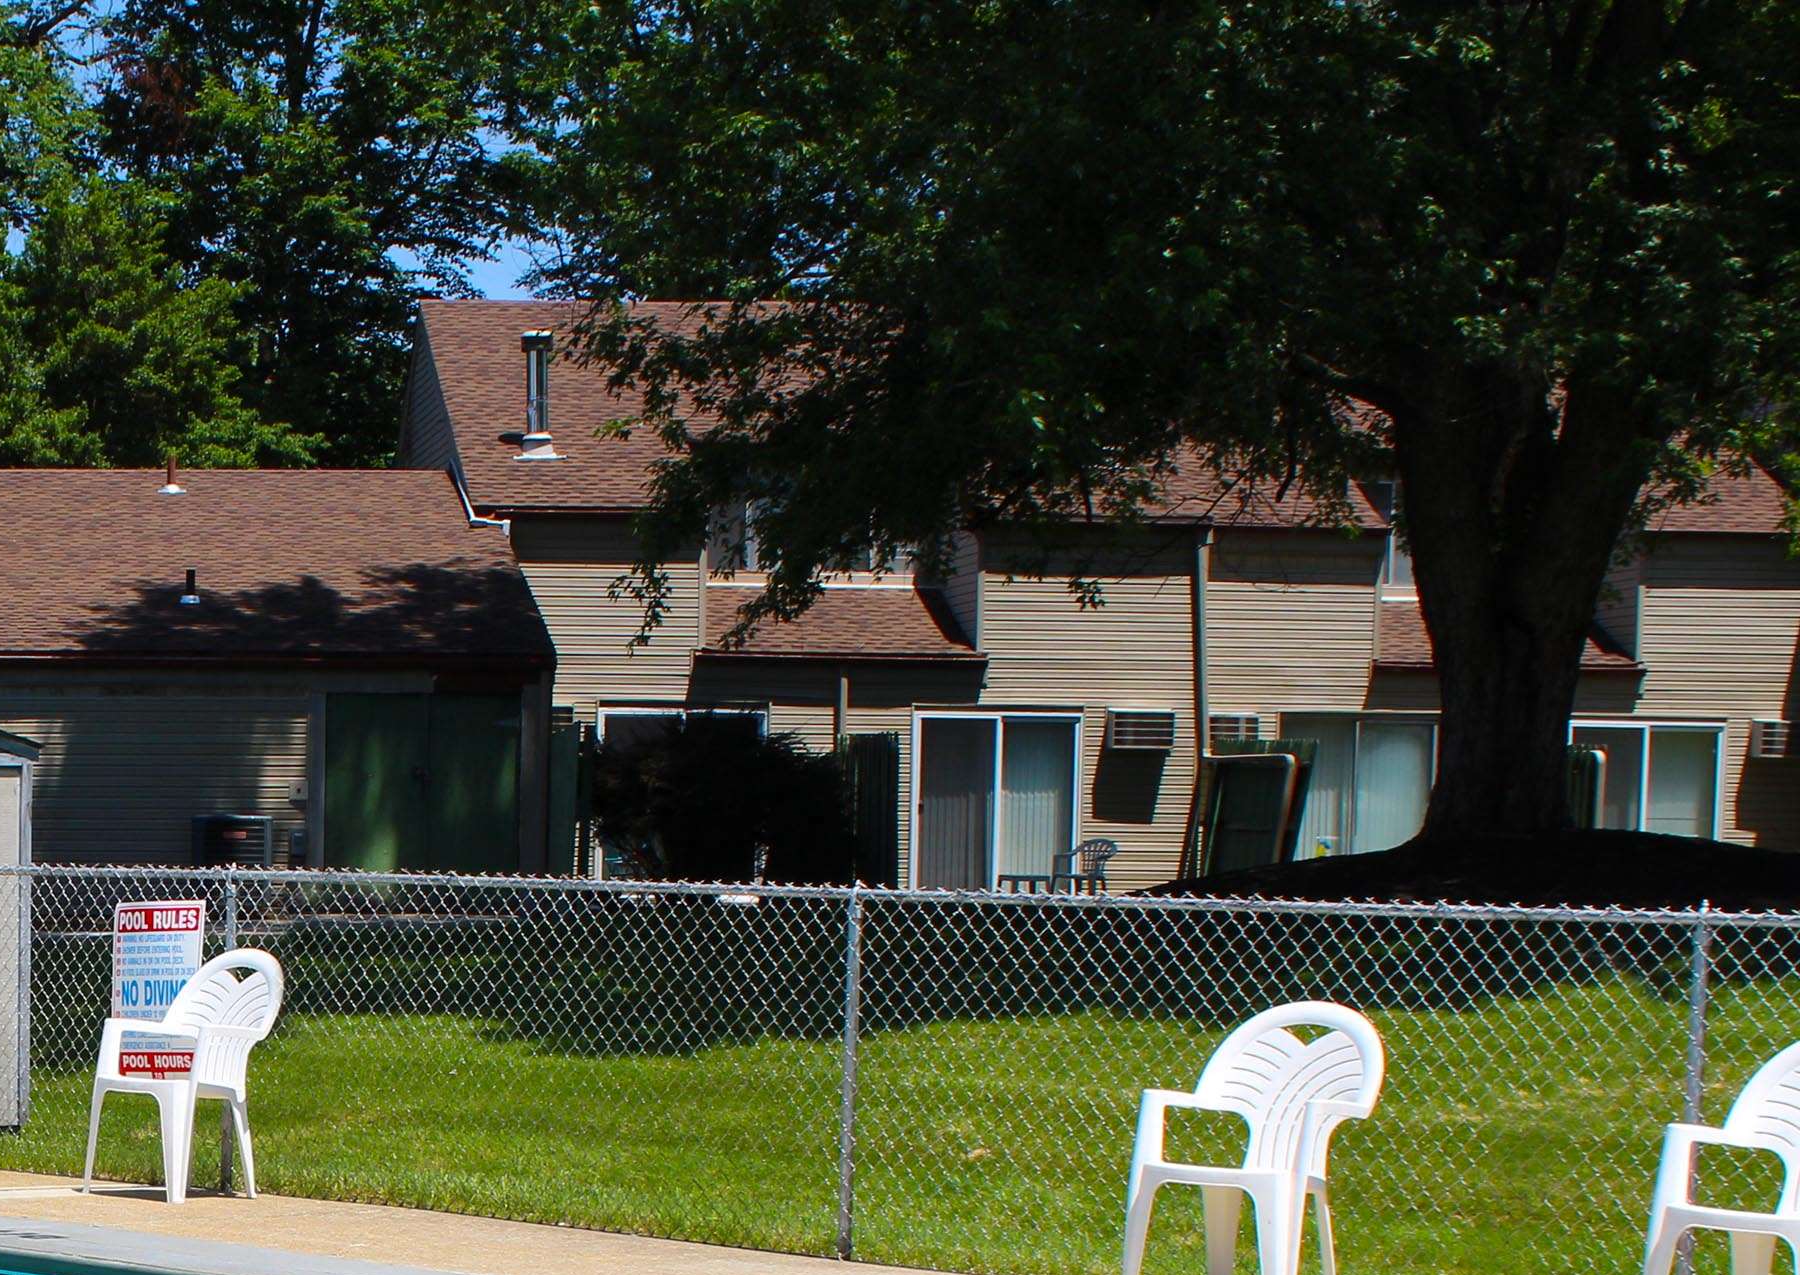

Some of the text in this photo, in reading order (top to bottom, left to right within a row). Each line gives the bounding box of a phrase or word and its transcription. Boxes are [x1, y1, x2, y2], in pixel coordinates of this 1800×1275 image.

[119, 909, 198, 931] POOL RULES
[121, 979, 187, 1007] NO DIVIN
[122, 1055, 192, 1068] POOL HOURS
